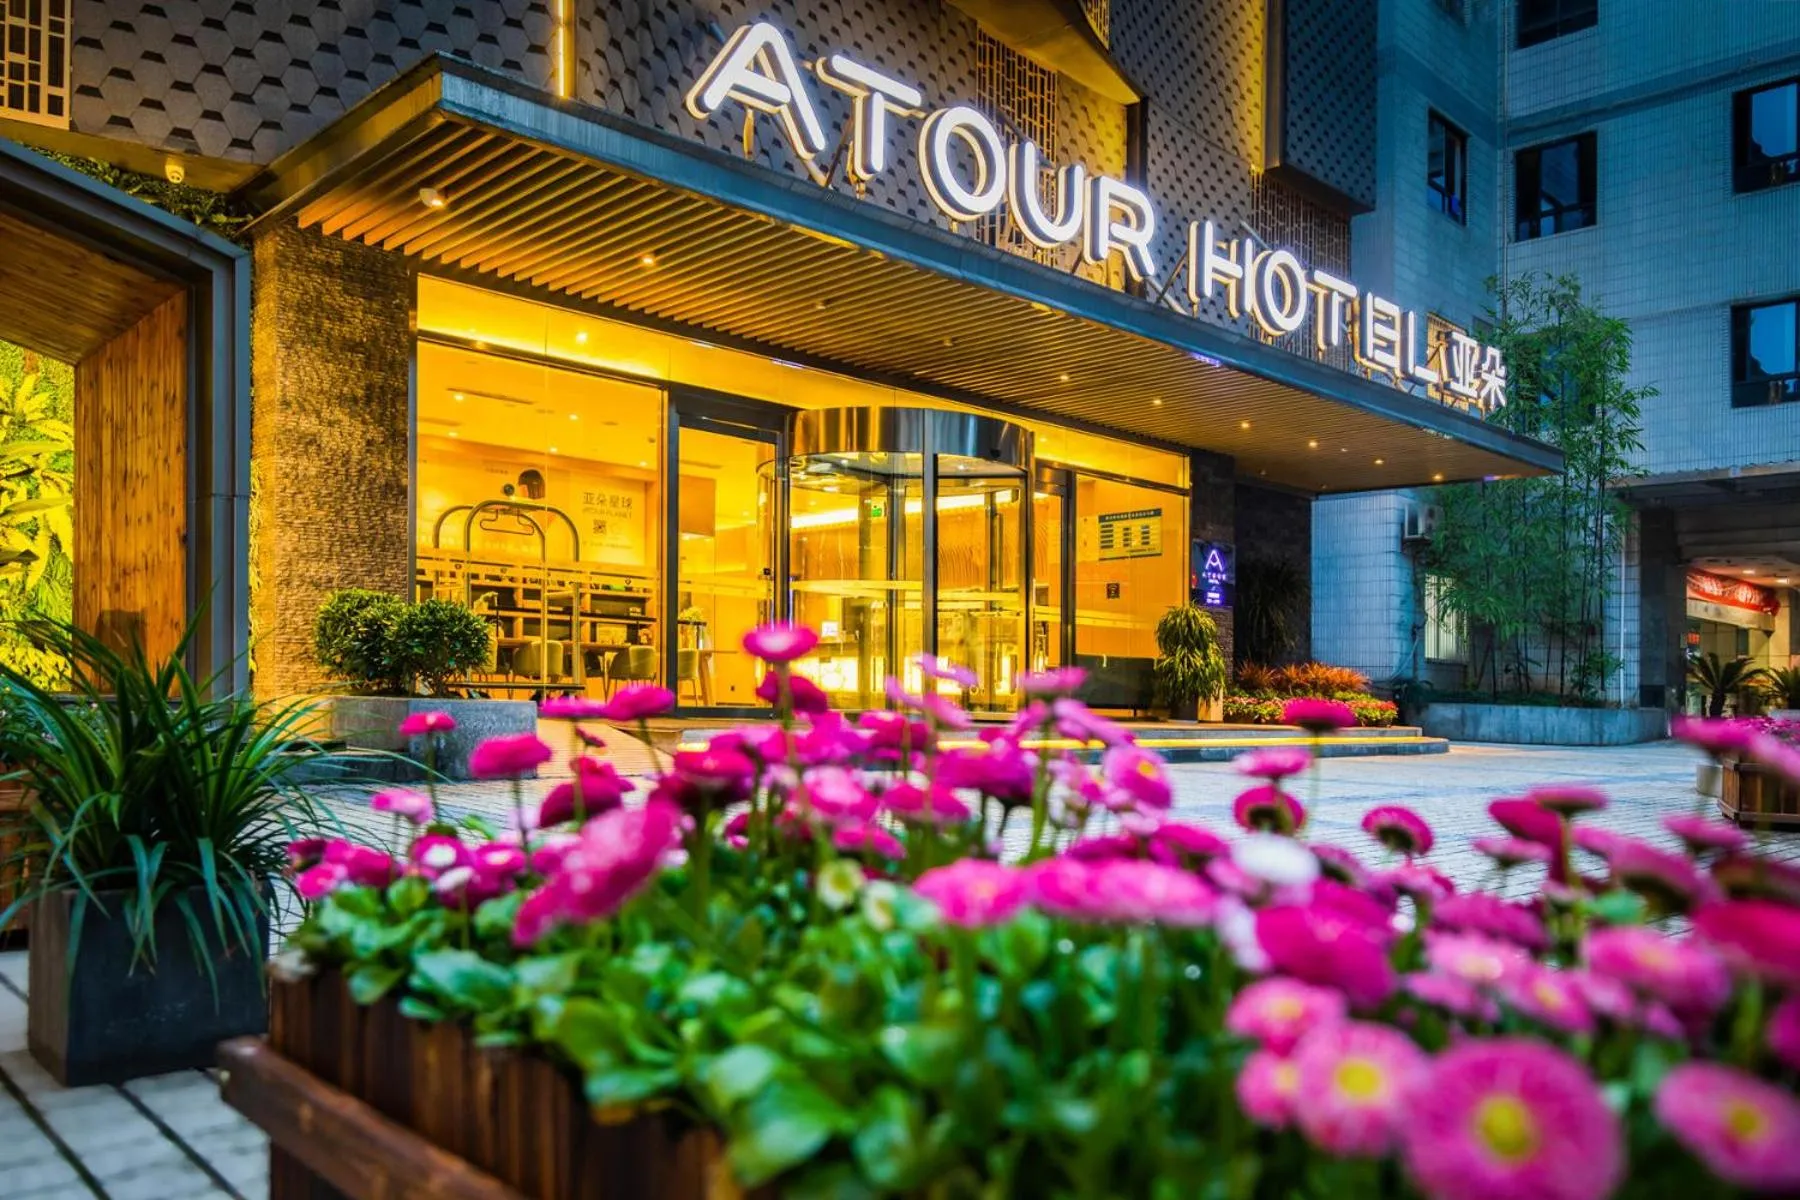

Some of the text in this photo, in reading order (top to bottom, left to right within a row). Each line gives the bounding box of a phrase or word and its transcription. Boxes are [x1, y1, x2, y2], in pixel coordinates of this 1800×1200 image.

[687, 20, 1441, 386] ATOUR HOTEL
[1449, 330, 1508, 412] 亚朵
